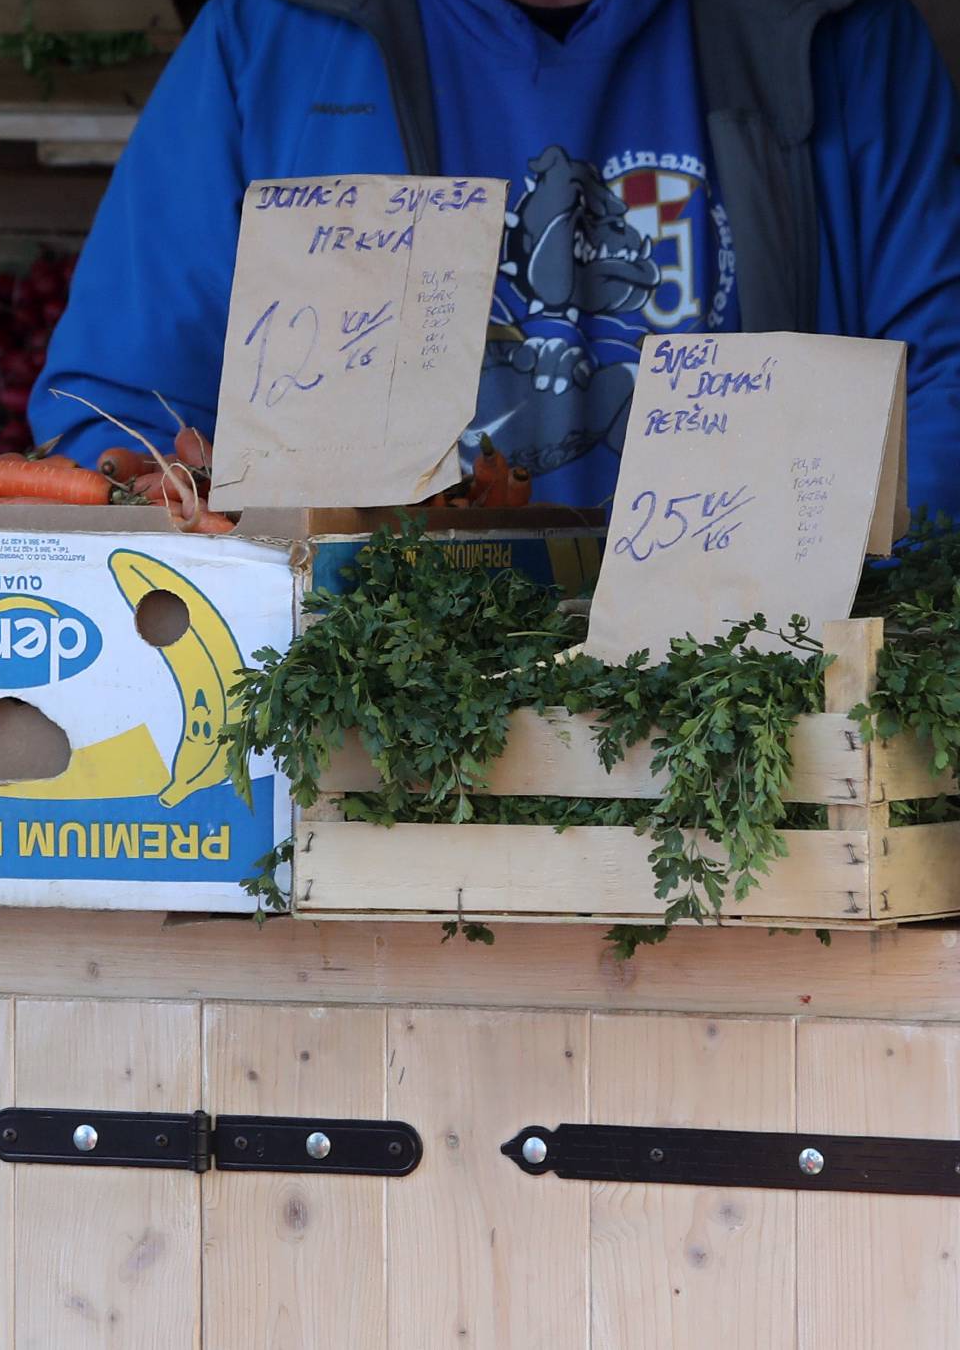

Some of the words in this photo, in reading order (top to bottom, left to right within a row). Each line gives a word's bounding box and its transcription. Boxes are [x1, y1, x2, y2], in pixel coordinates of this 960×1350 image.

[308, 225, 414, 254] MRKVA
[244, 300, 325, 408] 12
[644, 403, 729, 437] PERŠIN
[614, 490, 701, 562] 25
[18, 821, 231, 861] PREMIUM
